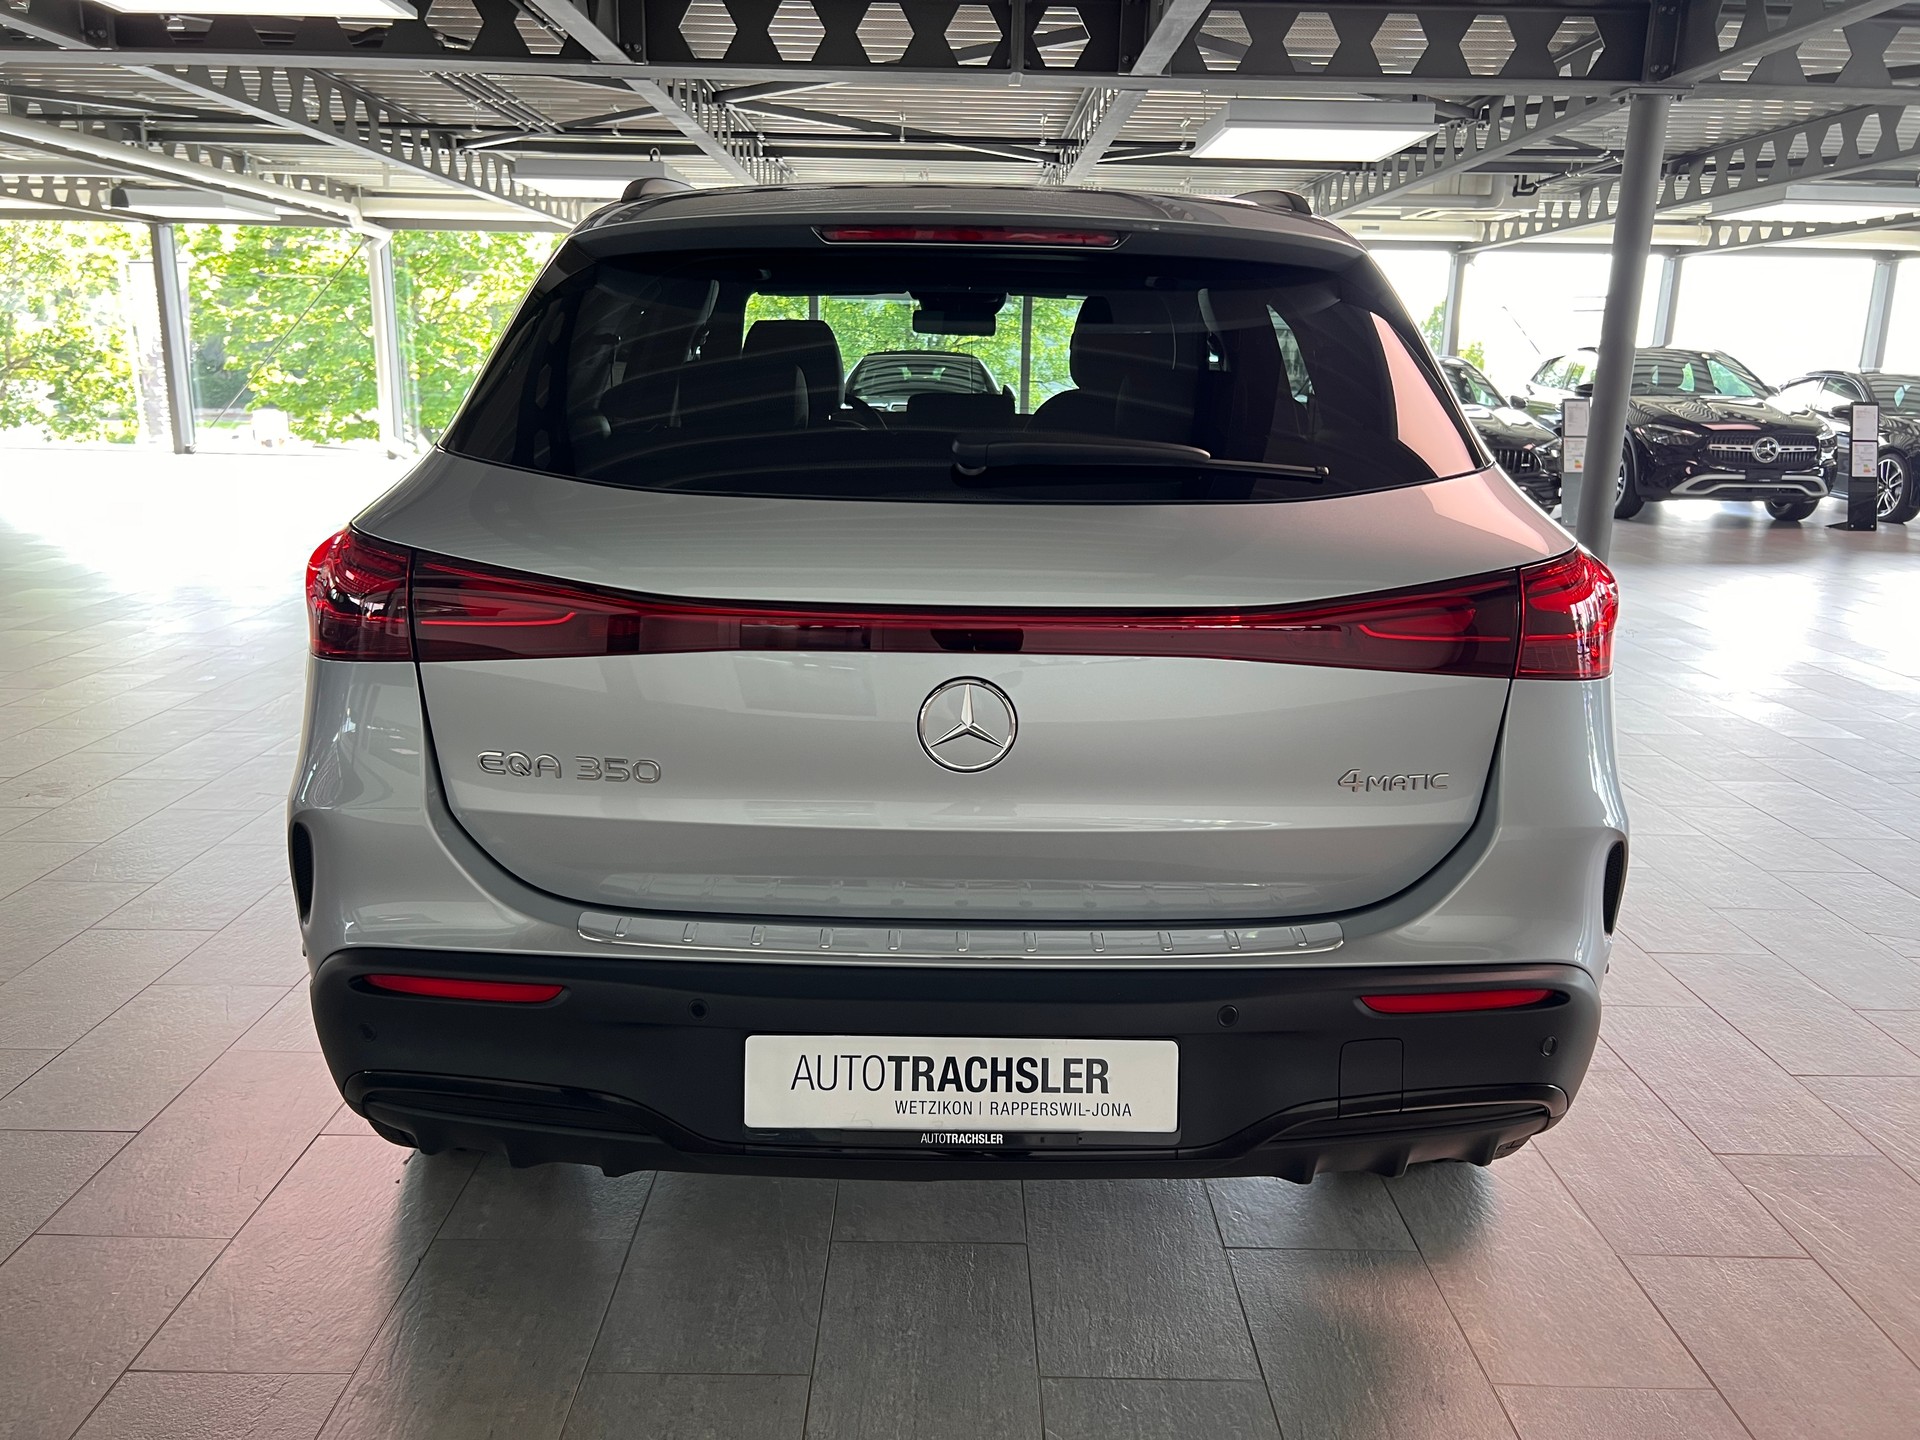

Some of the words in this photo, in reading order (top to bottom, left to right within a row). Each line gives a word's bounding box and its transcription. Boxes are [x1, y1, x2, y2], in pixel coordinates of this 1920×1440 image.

[477, 750, 561, 779] EQA
[575, 755, 662, 784] 350
[1337, 768, 1450, 793] 4MATIC
[791, 1054, 1109, 1094] AUTOTRACHSLER
[895, 1099, 973, 1115] WETZIKON
[989, 1102, 1132, 1118] RAPPERSWIL-JONA
[920, 1132, 1004, 1145] AUTOTRACHSLER
